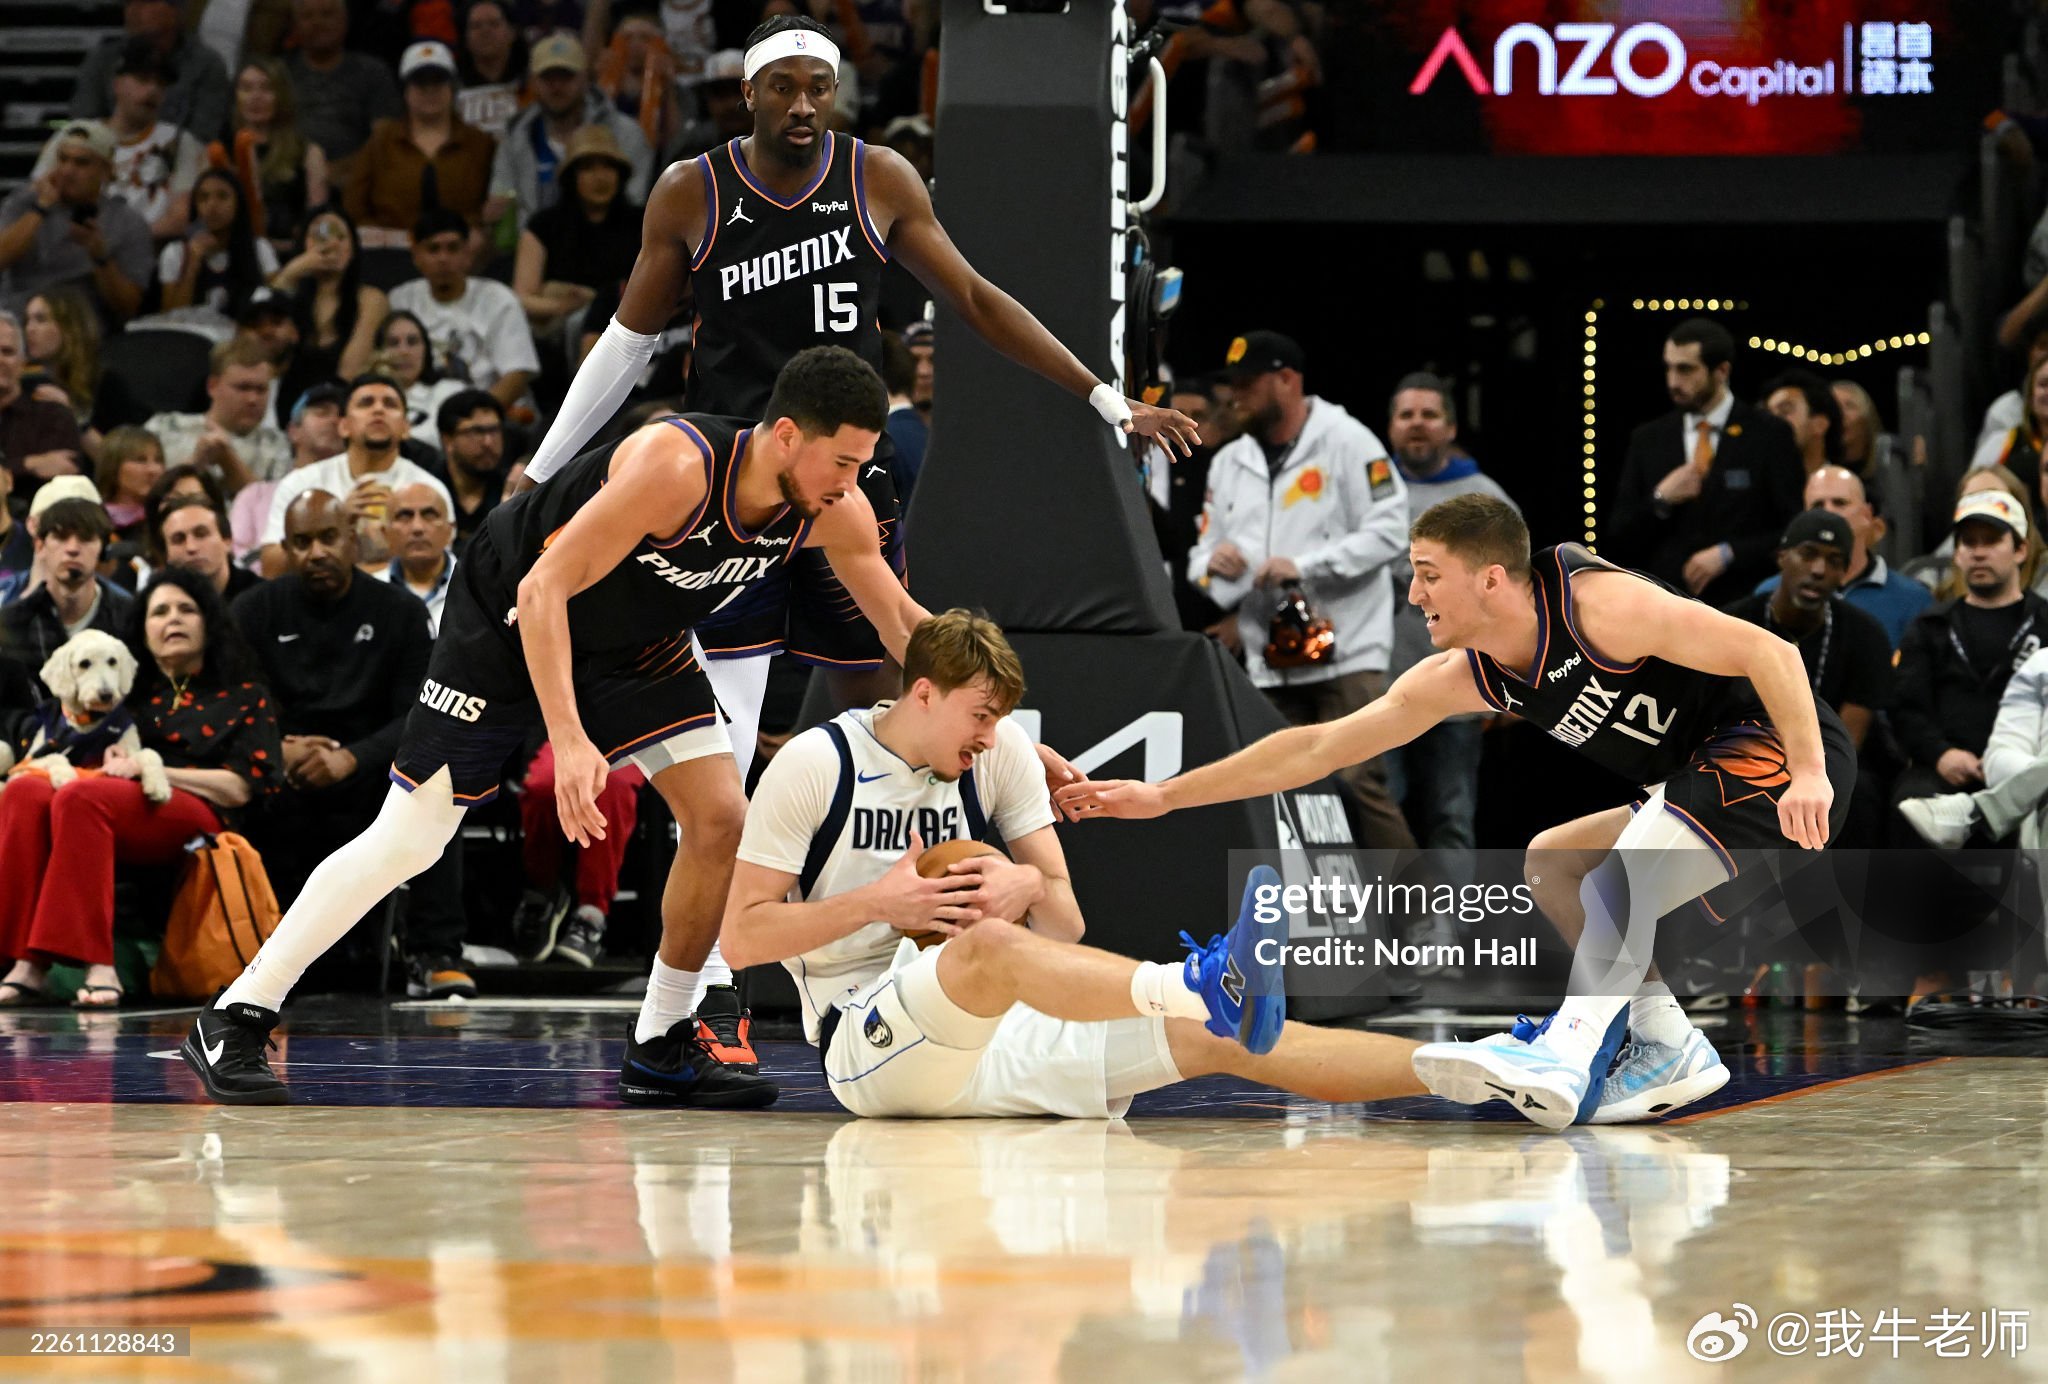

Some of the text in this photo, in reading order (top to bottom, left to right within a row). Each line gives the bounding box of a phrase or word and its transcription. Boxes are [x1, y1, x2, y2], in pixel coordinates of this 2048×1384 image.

[1689, 58, 1834, 106] Capital
[812, 201, 848, 214] PayPal
[719, 225, 856, 301] PHOENIX
[813, 282, 858, 332] 15
[754, 536, 792, 548] PayPal
[1547, 652, 1582, 683] PayPal
[420, 678, 487, 722] SUNS
[1546, 675, 1621, 748] HOENIX
[1611, 693, 1677, 746] 12
